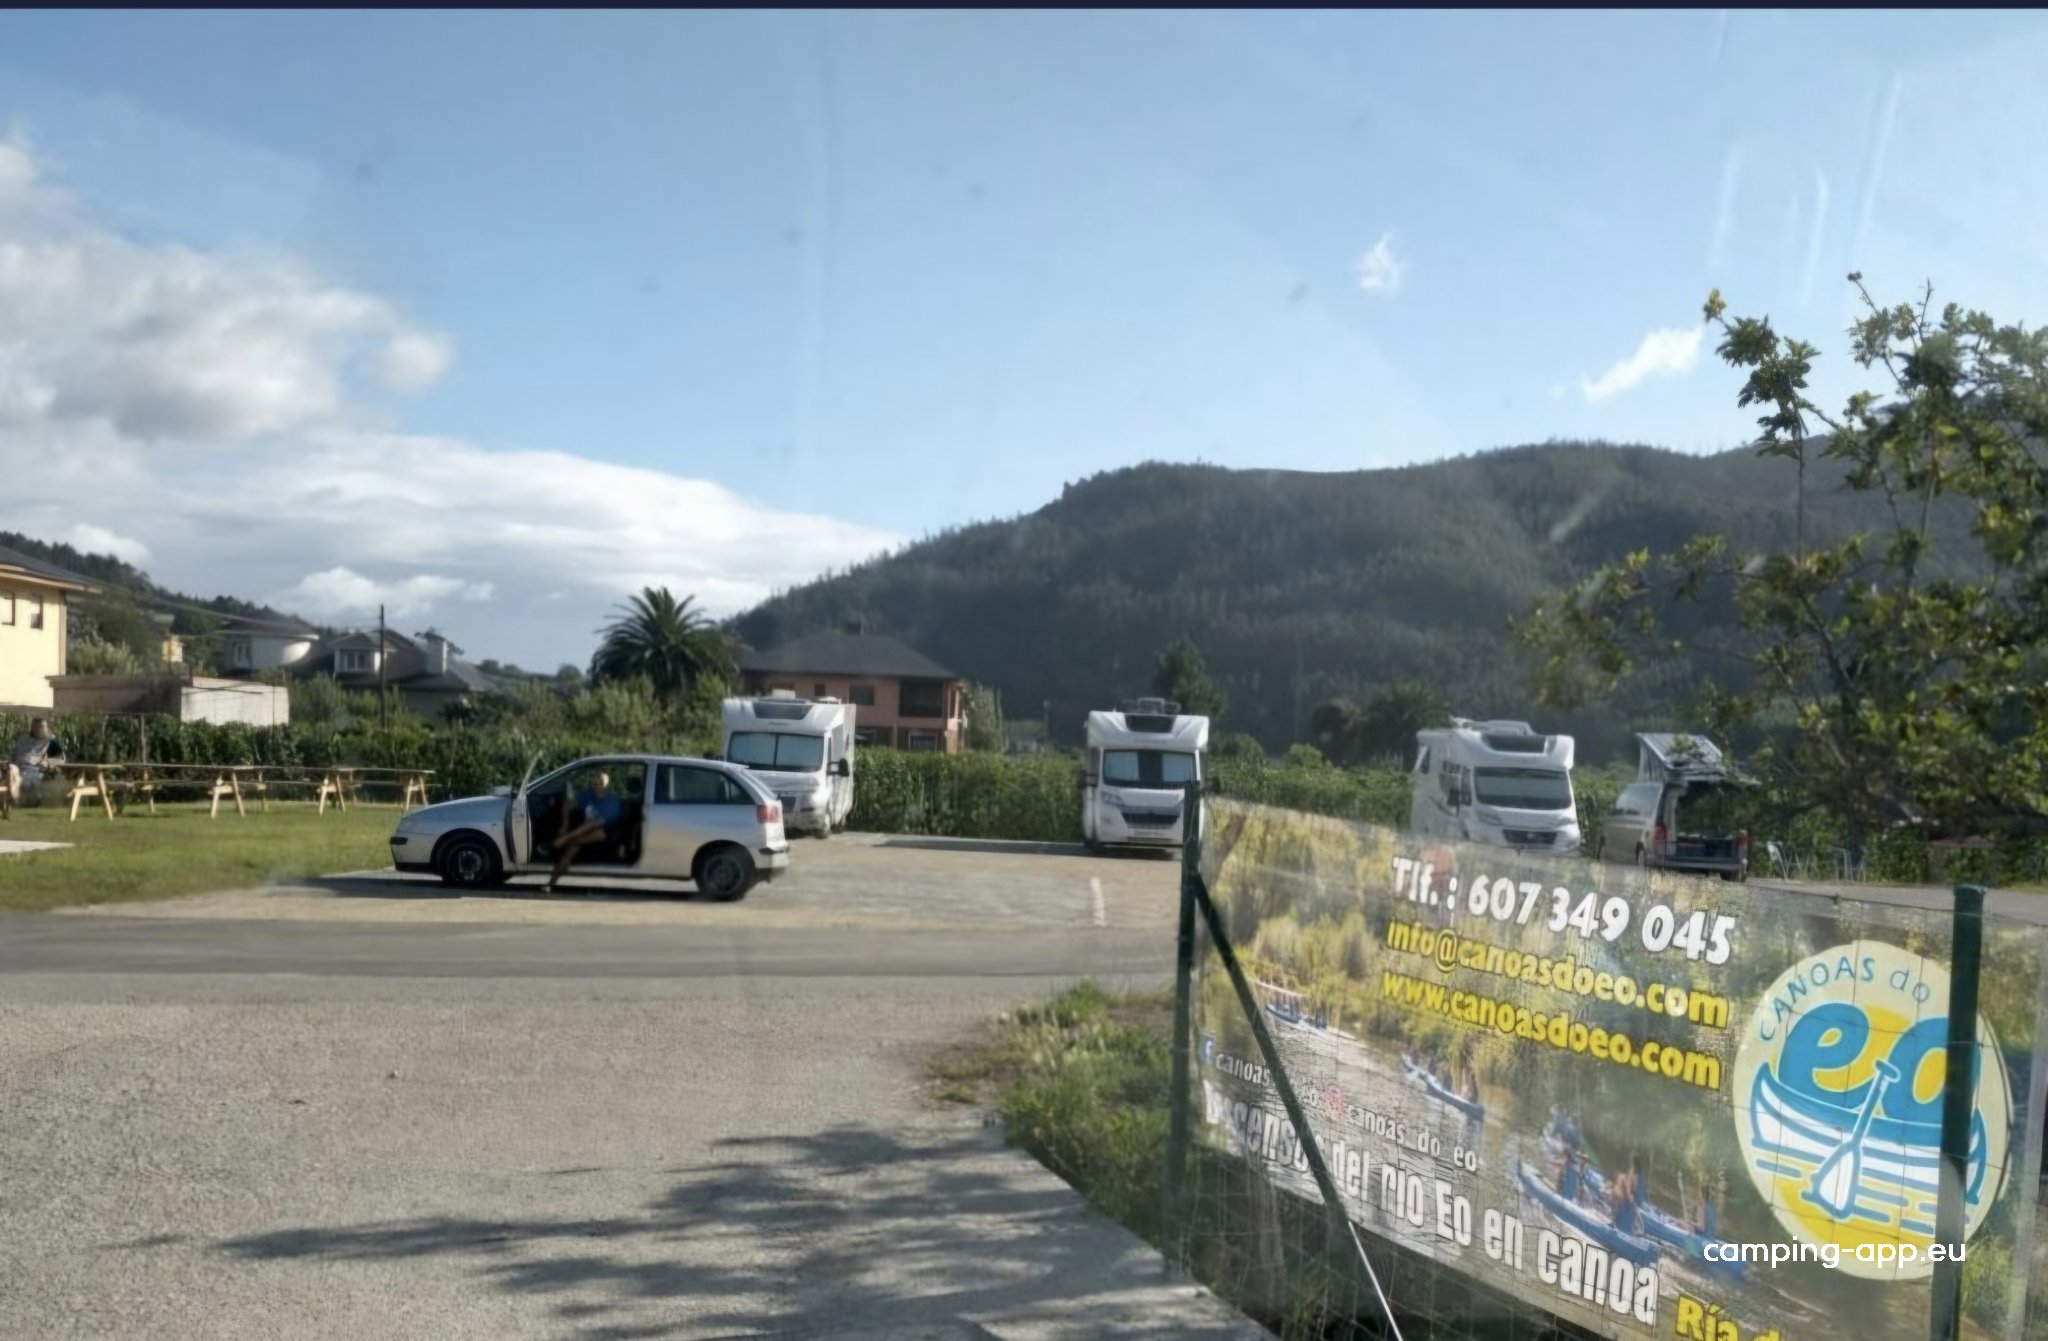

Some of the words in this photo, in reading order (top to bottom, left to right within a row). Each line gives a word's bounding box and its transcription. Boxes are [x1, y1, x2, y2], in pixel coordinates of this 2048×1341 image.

[1387, 917, 1729, 1029] info@canoasdoeo.com
[1468, 874, 1542, 925] 607
[1550, 886, 1630, 941] 349
[1642, 905, 1736, 965] 045
[1382, 972, 1720, 1089] www.canoasdoeo.com
[1760, 955, 1876, 1042] CANOAS
[1332, 1139, 1370, 1201] del
[1435, 1179, 1472, 1246] Eo
[1484, 1208, 1523, 1270] en
[1538, 1229, 1659, 1326] canoa
